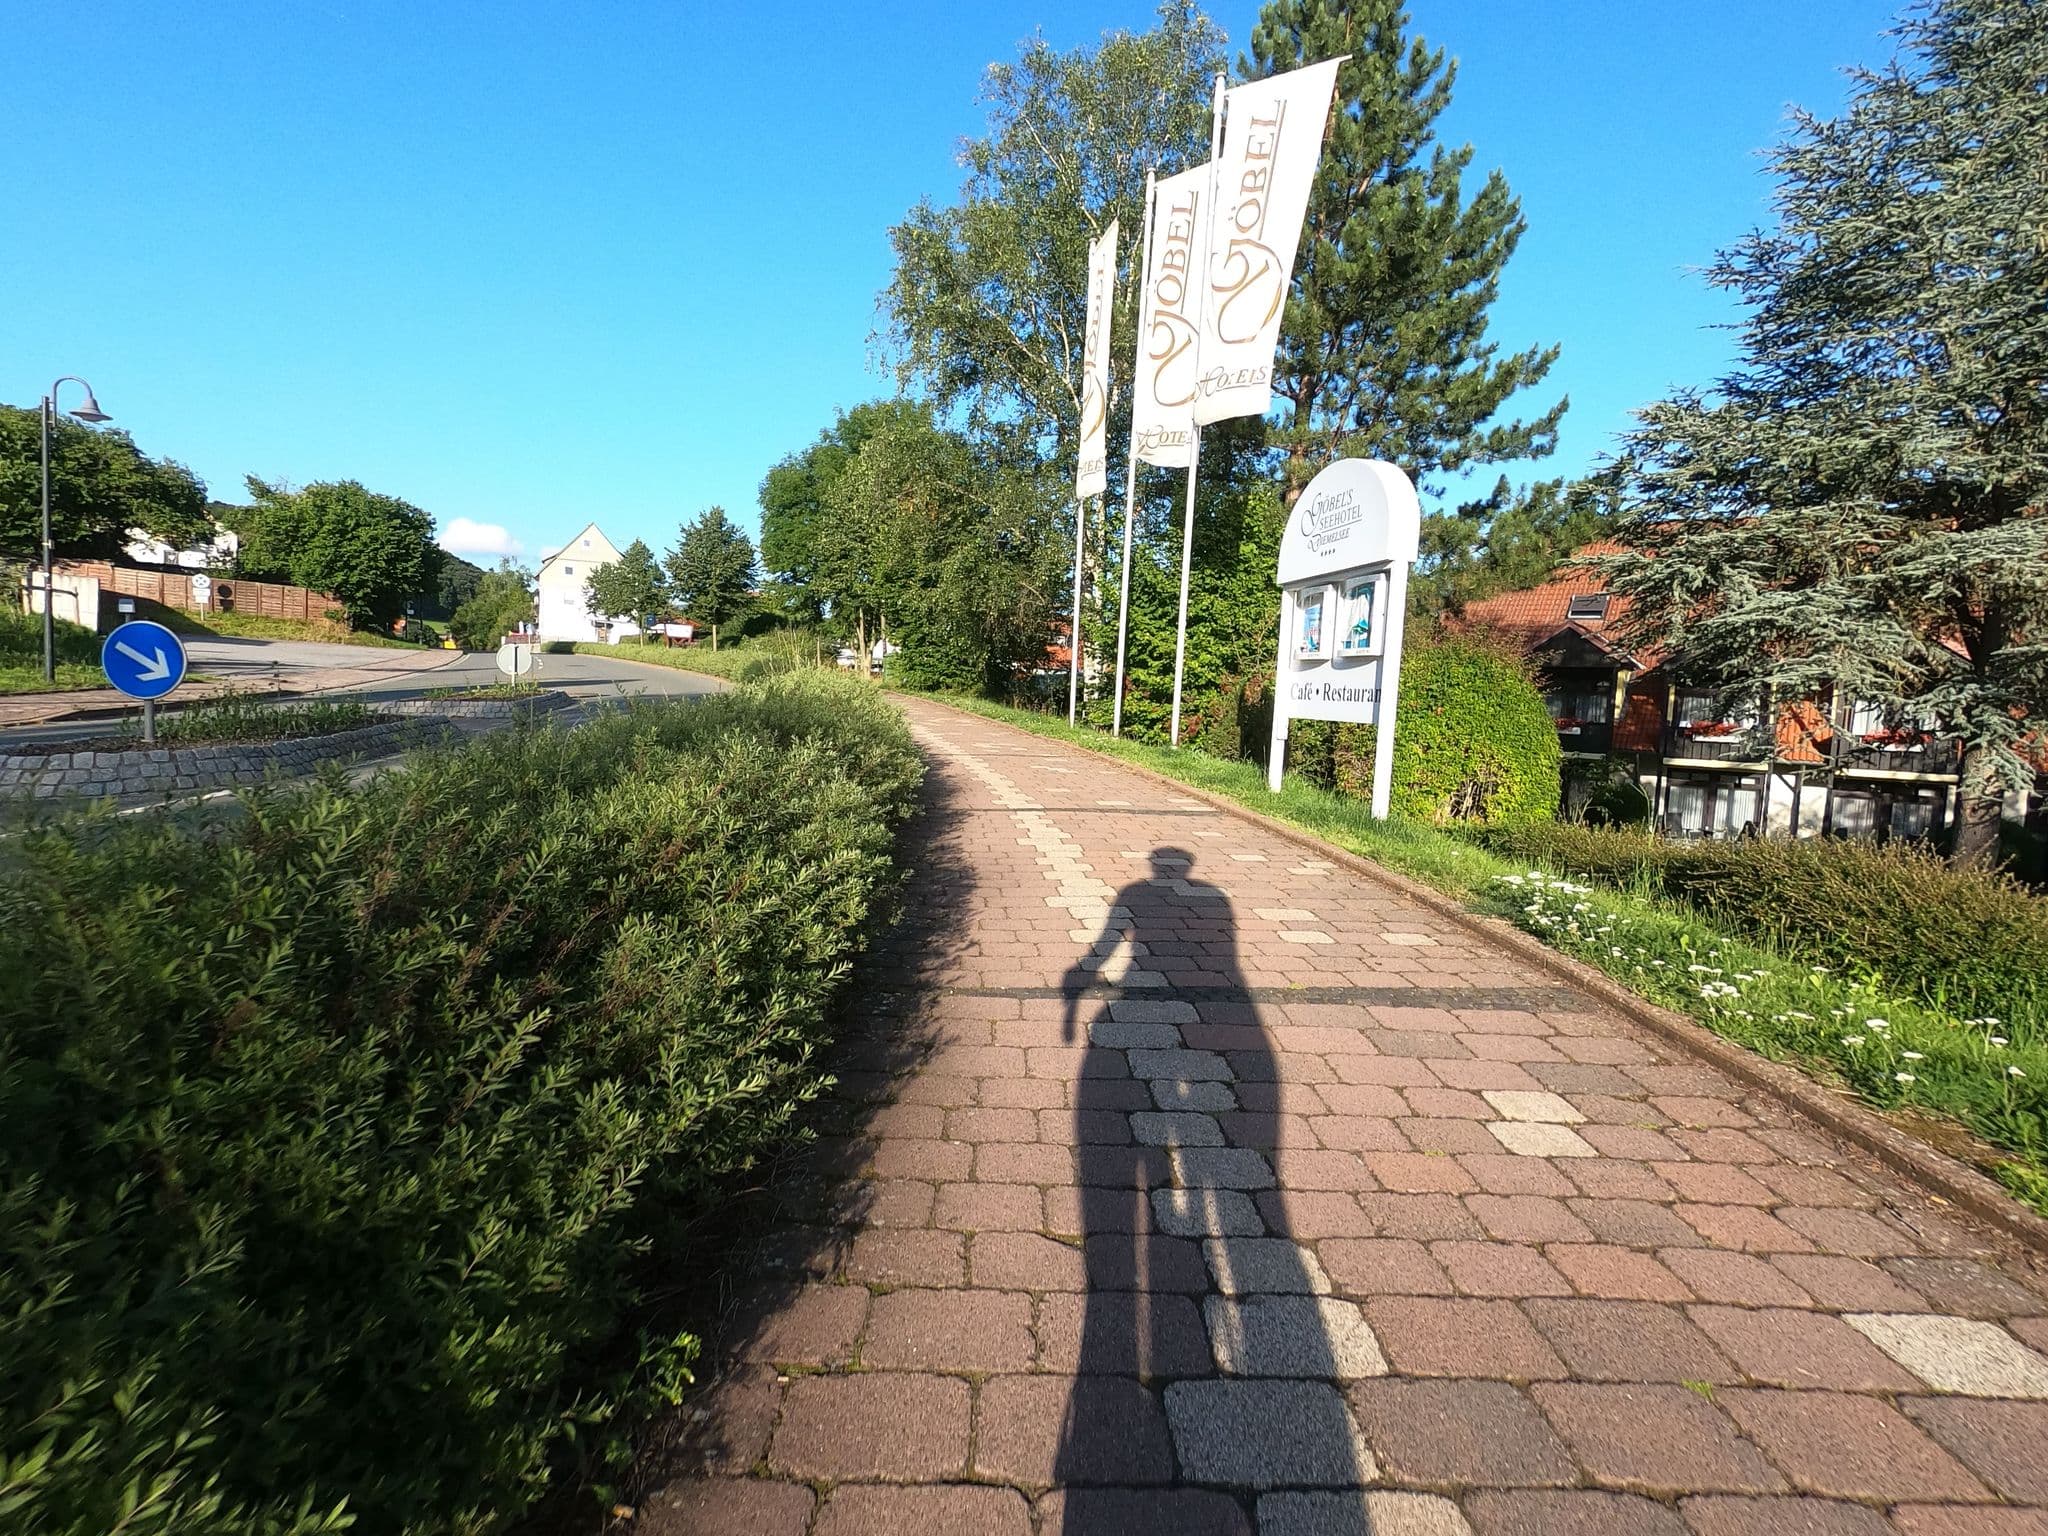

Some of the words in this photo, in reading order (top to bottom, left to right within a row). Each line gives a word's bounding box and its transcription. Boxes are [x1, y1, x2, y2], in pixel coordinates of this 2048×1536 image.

[1320, 504, 1363, 530] SEEHOTEL
[1290, 682, 1313, 701] Café
[1322, 682, 1382, 703] Restauran
